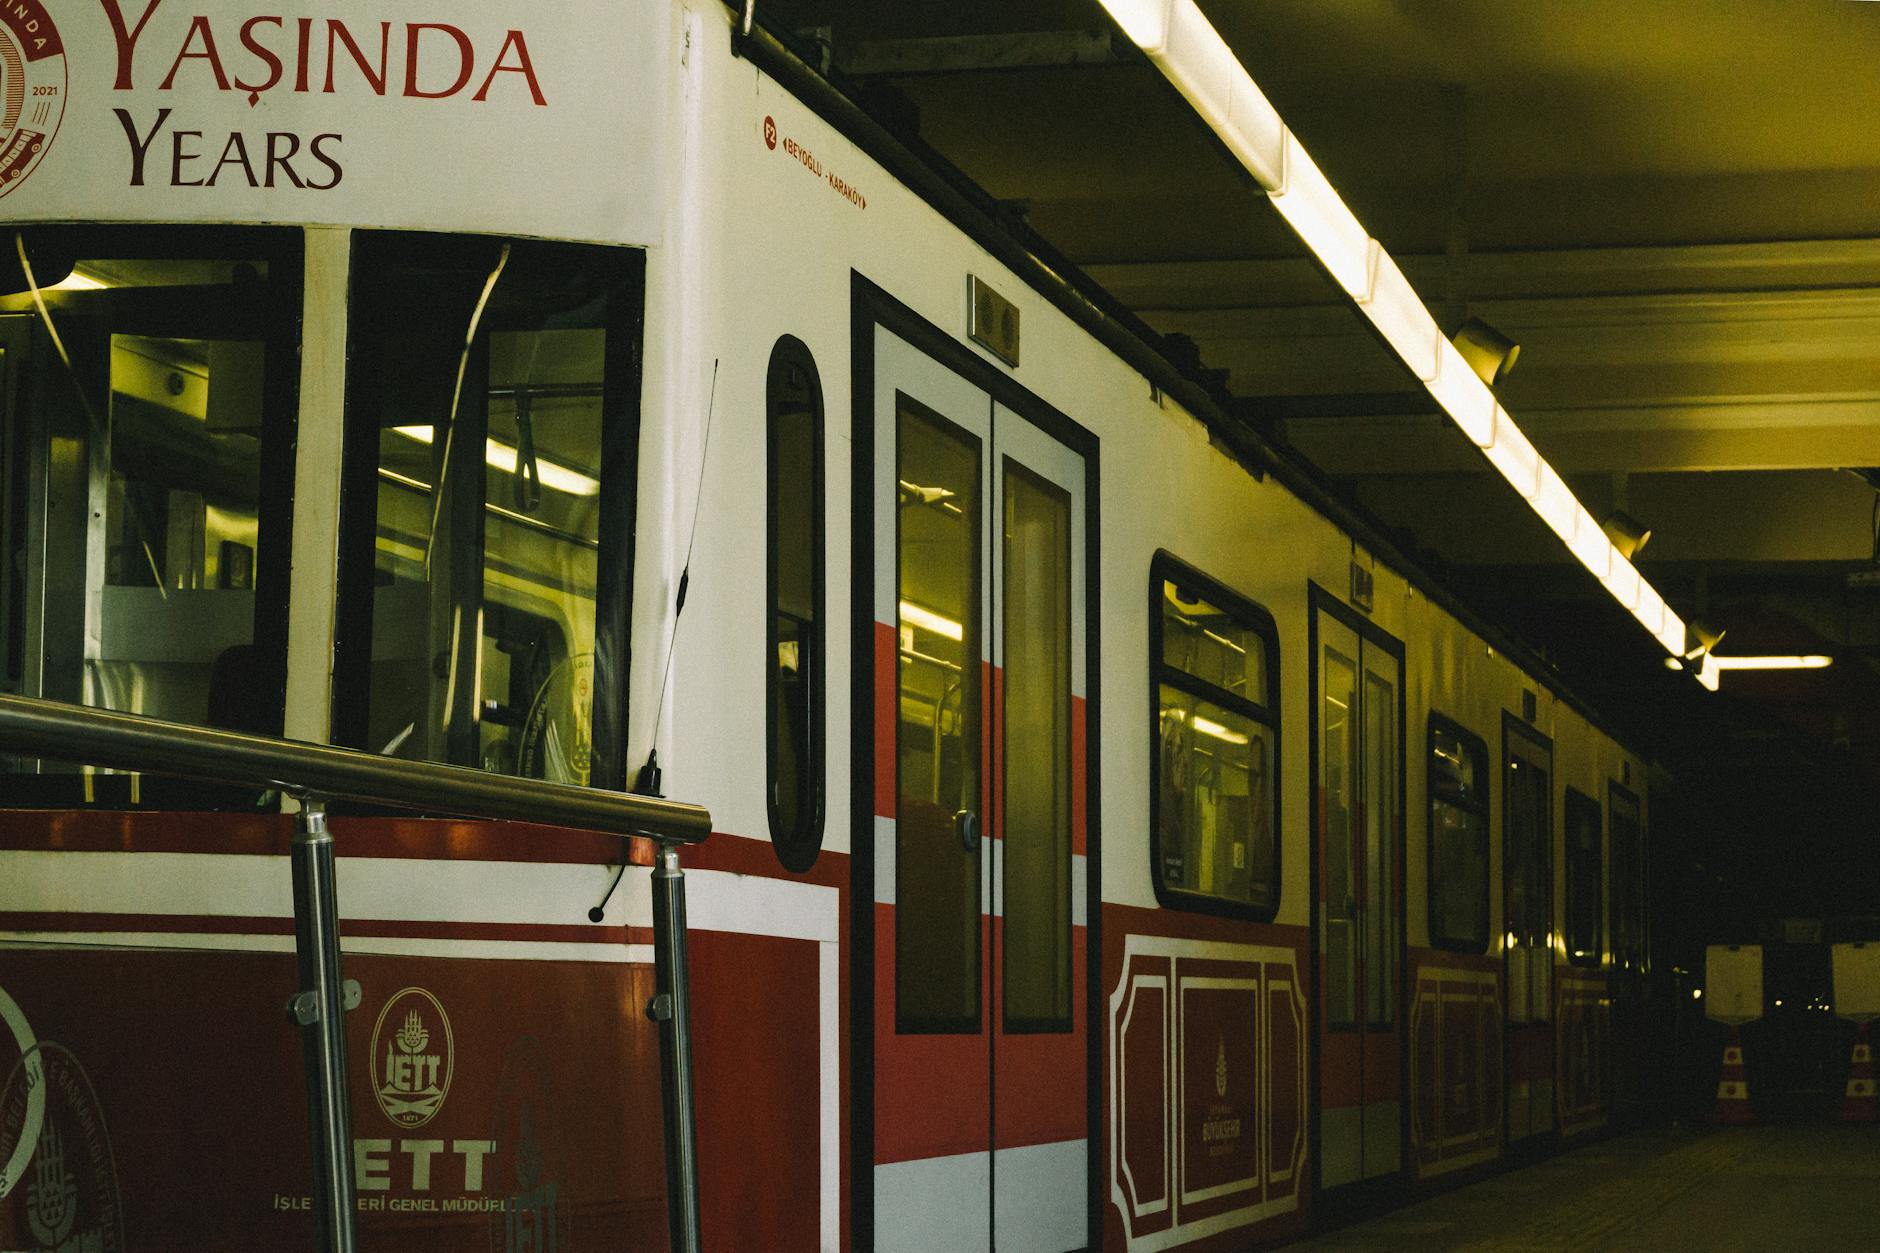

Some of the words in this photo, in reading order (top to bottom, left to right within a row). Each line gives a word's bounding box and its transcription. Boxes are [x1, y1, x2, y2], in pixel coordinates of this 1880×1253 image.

[100, 0, 548, 108] YAŞINDA
[32, 86, 59, 96] 2021
[112, 108, 344, 190] YEARS
[765, 121, 776, 144] F2
[788, 138, 822, 178] BEYOĞLU
[829, 171, 862, 209] KARAKÖY
[353, 1139, 497, 1191] ETT
[388, 1199, 439, 1212] GENEL
